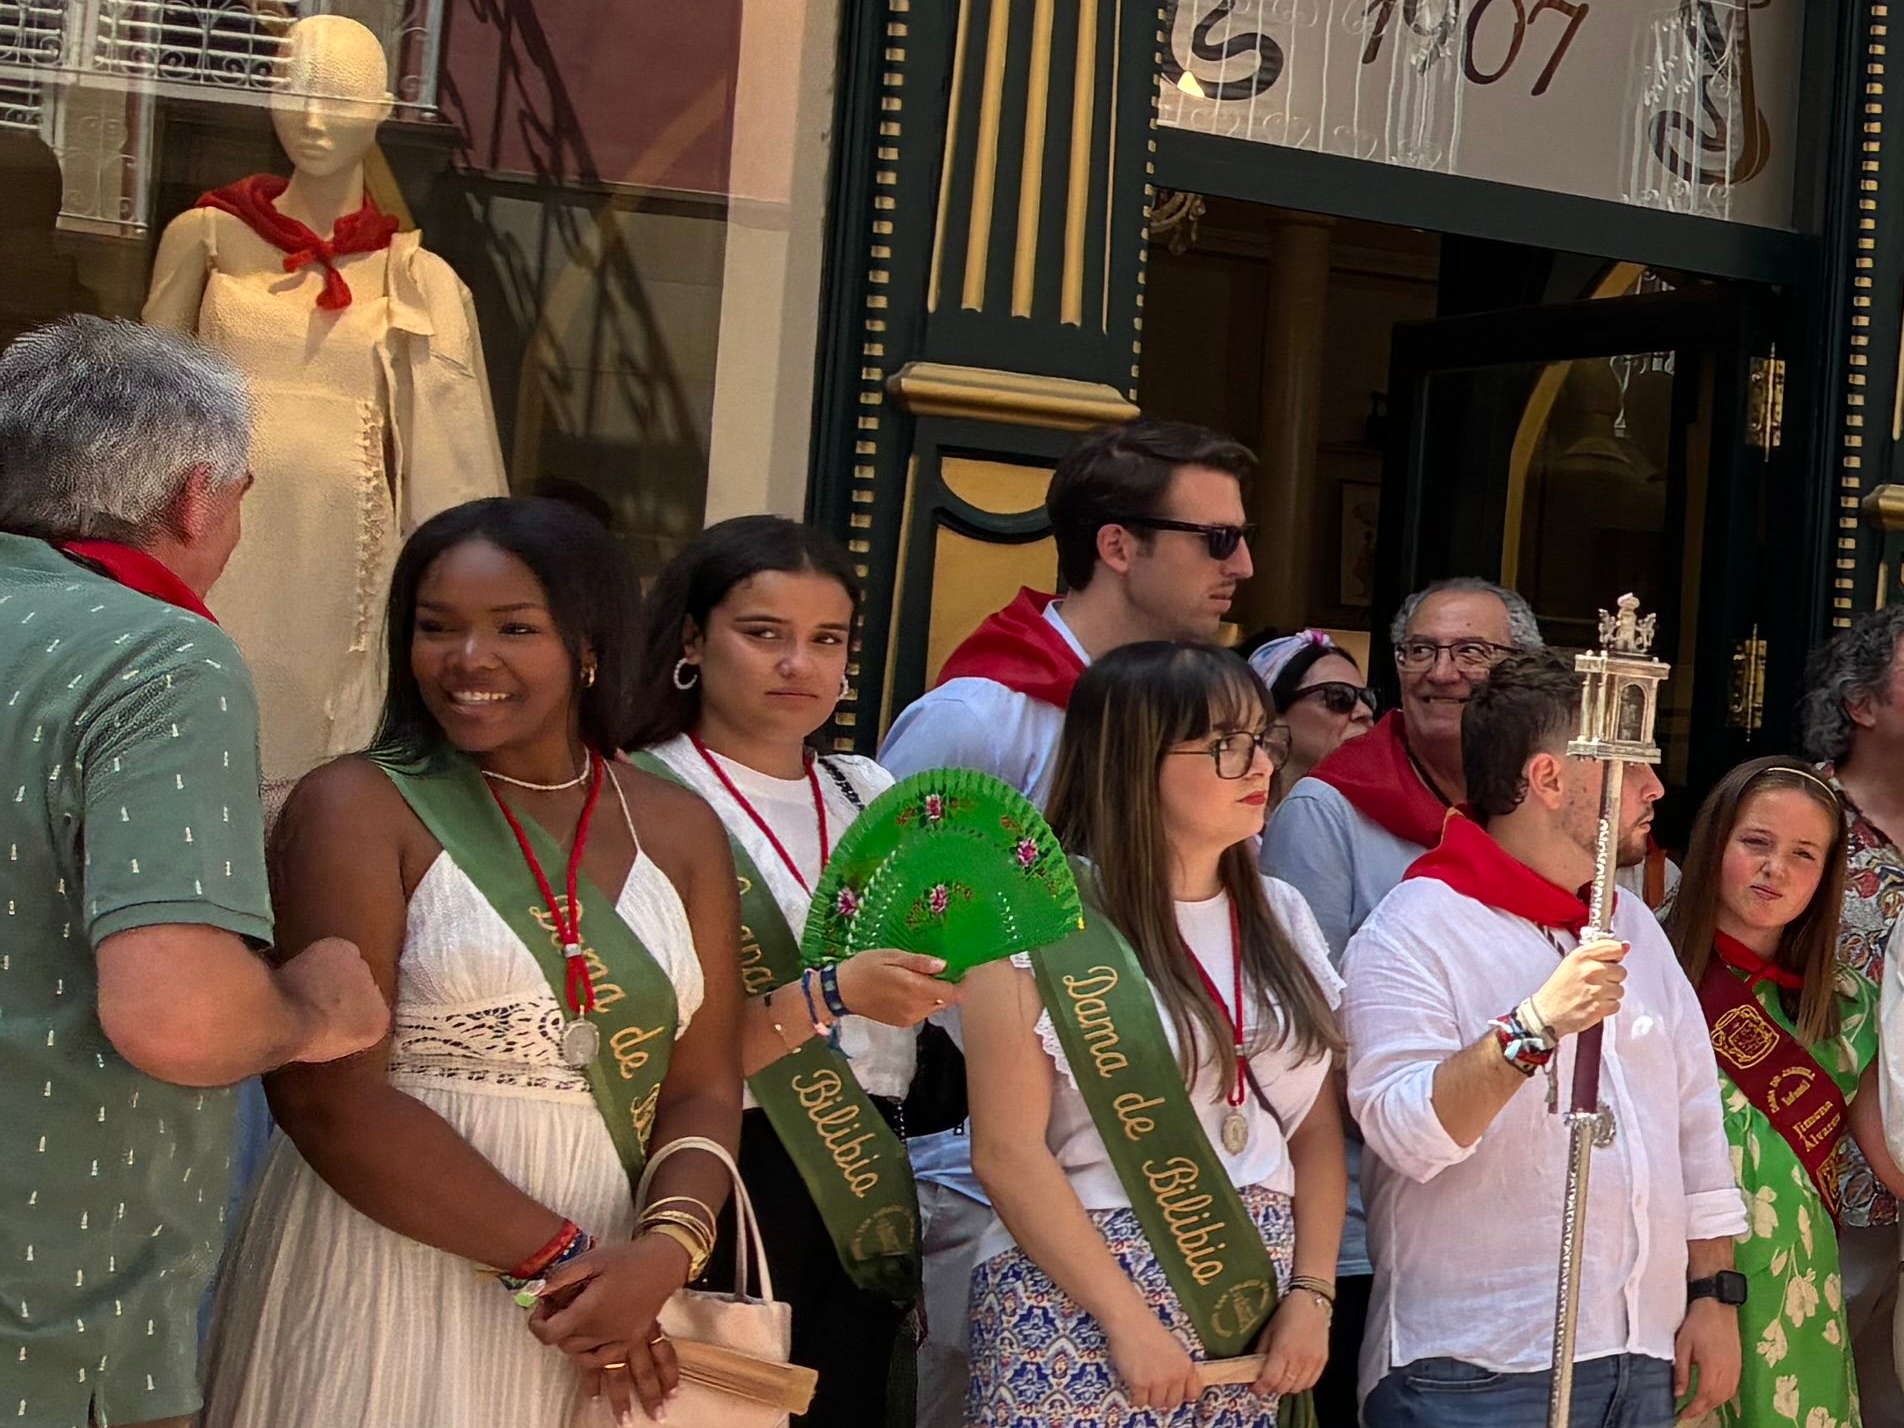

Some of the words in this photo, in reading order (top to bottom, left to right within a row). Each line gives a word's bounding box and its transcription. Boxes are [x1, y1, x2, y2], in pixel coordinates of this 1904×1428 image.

[610, 1026, 666, 1080] de
[792, 1068, 881, 1199] Bilibio
[1062, 966, 1128, 1080] Dama
[1112, 1093, 1167, 1143] de
[1142, 1158, 1224, 1287] Bilibio
